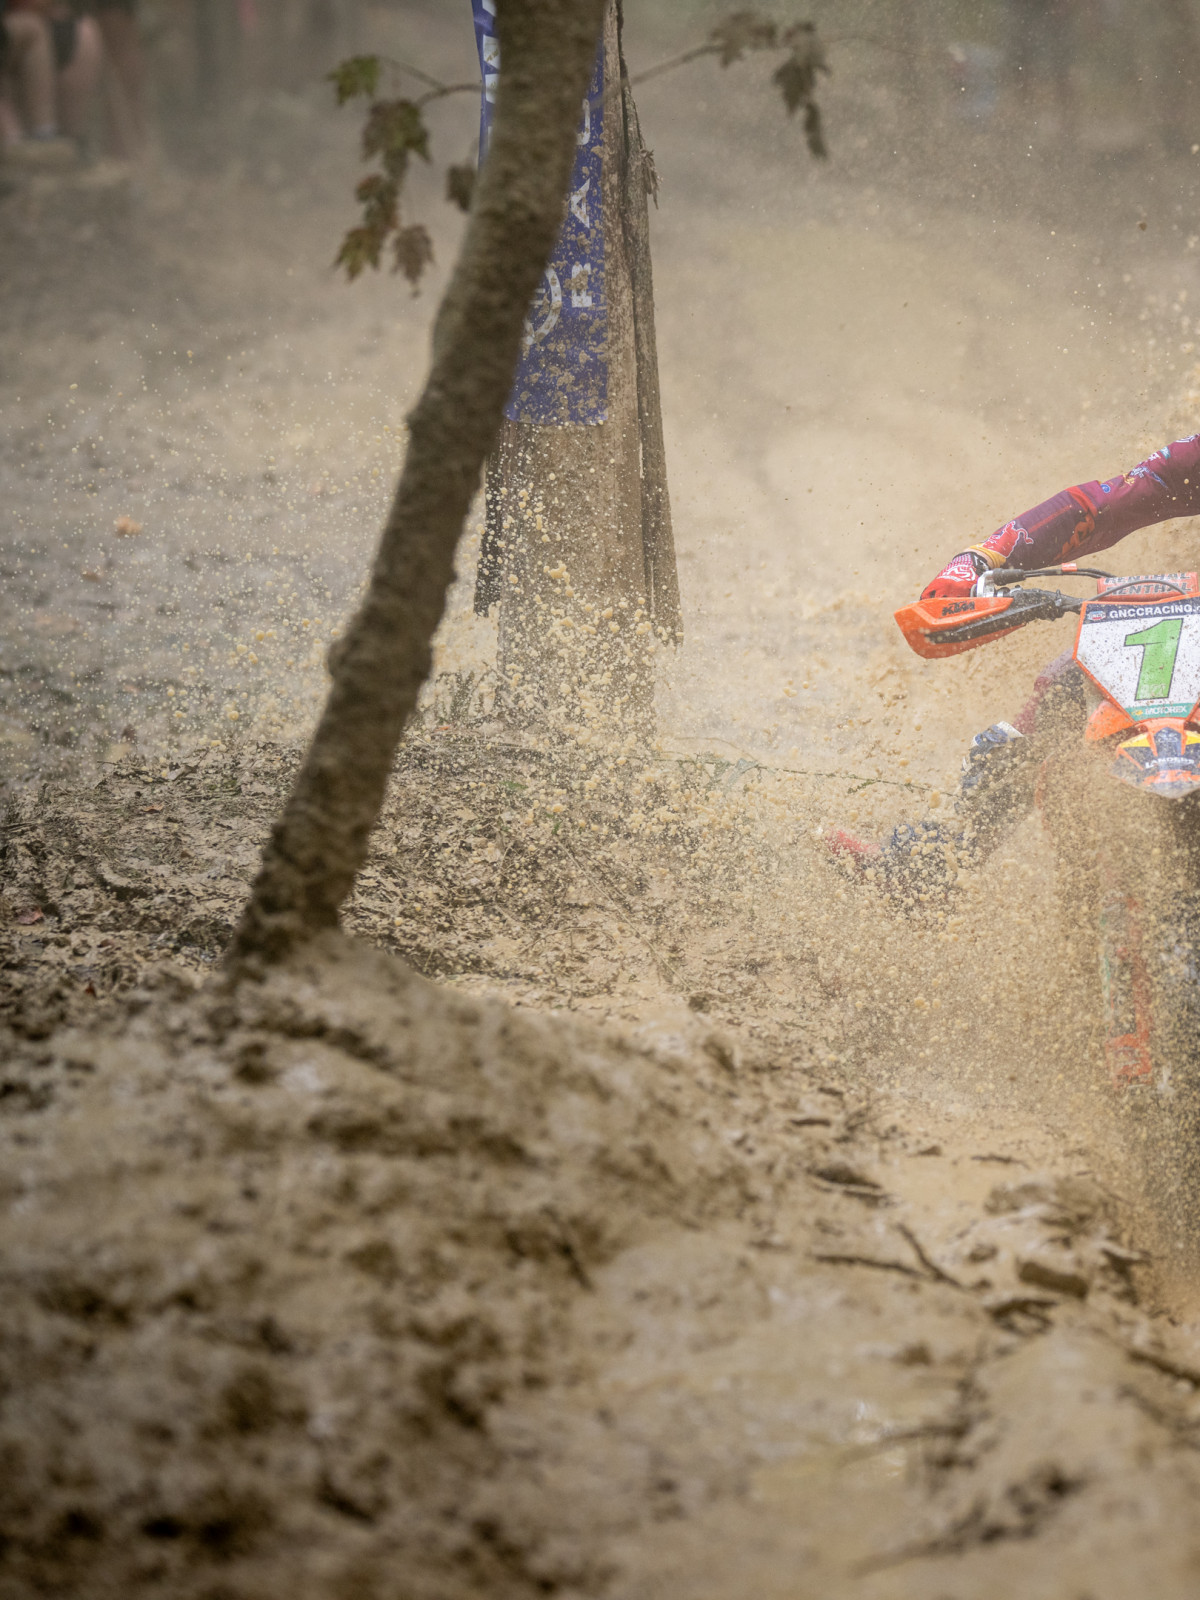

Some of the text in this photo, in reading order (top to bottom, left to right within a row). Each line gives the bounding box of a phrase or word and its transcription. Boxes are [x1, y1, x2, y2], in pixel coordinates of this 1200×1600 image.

[942, 602, 975, 616] KTM
[1123, 618, 1185, 701] 1
[1145, 705, 1187, 716] MOTOREX
